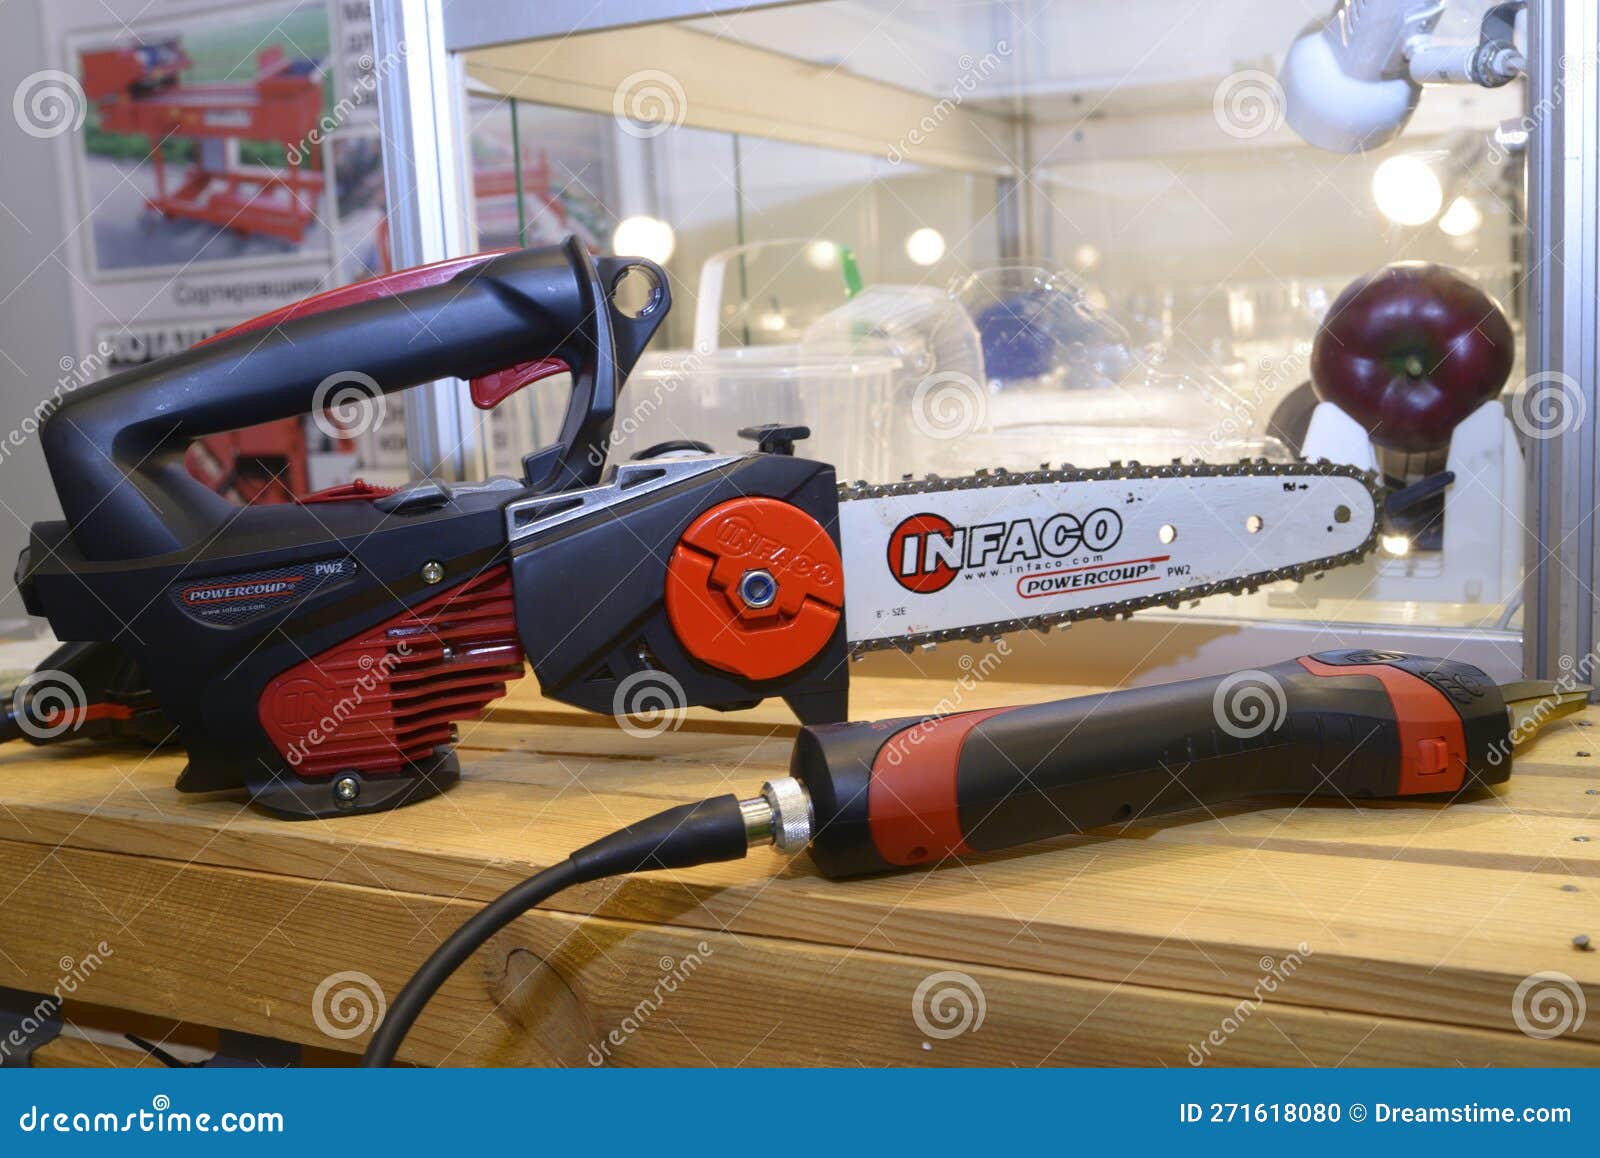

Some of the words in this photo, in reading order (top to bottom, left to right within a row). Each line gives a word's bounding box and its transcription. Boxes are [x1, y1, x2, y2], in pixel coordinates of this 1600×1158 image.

[901, 507, 1123, 577] INFACO
[315, 562, 344, 576] PW2
[964, 553, 1104, 581] www.infaco.com
[1167, 564, 1192, 577] PW2
